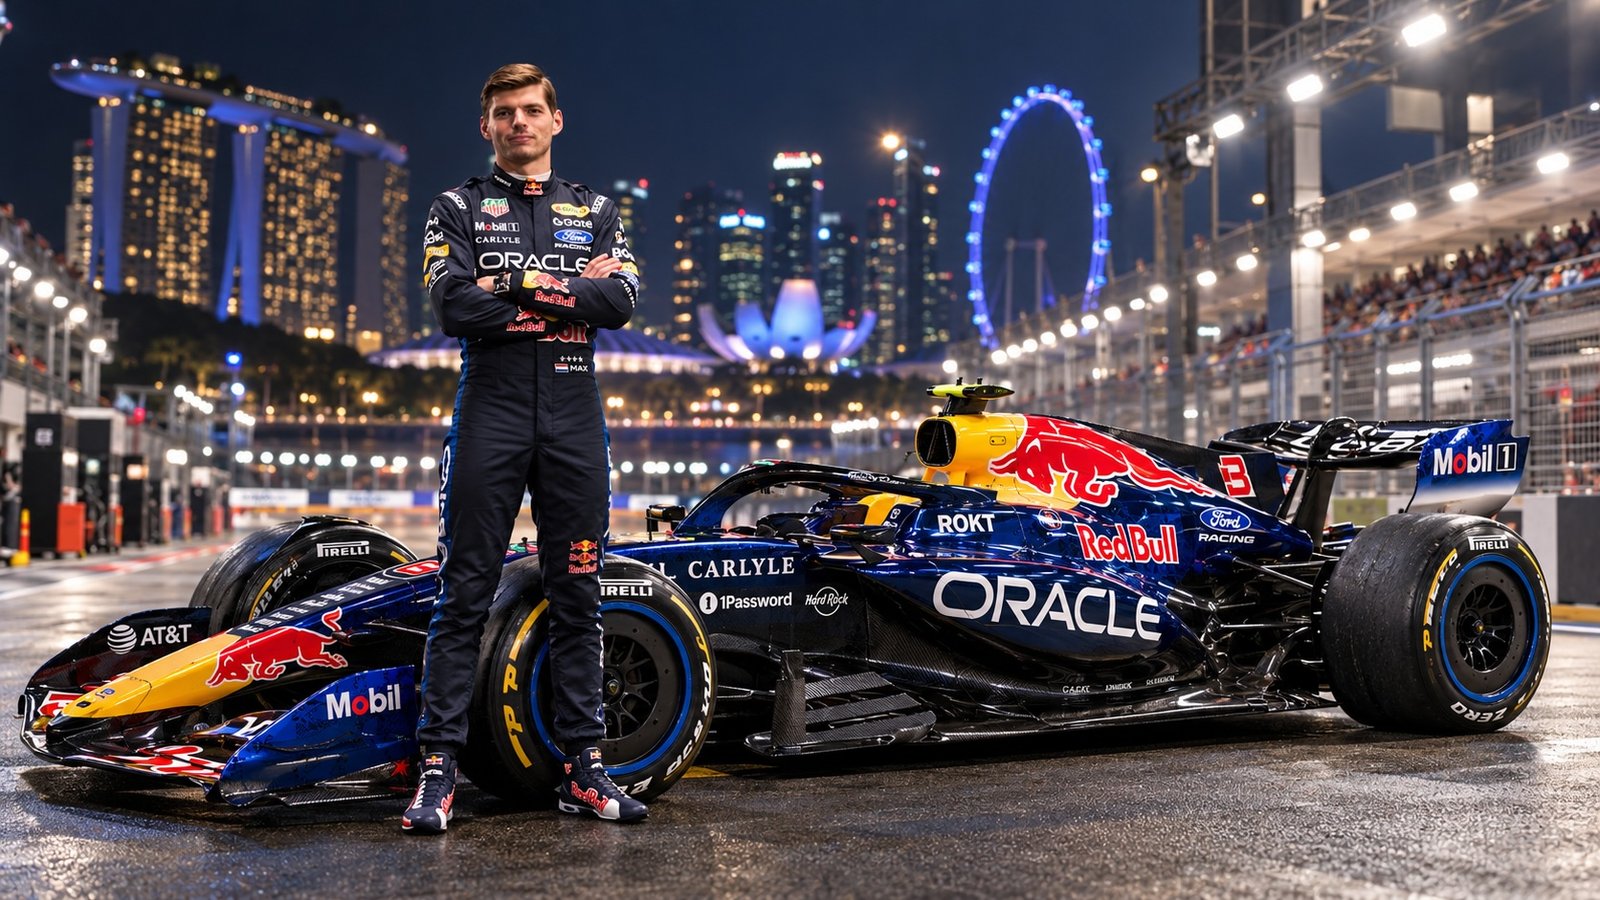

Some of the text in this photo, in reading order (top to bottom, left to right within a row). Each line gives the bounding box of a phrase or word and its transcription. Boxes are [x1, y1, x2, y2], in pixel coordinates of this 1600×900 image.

[475, 236, 520, 244] CARLYLE
[479, 252, 590, 272] ORACLE
[1433, 444, 1493, 475] Mobil
[1217, 455, 1256, 497] 3
[937, 513, 996, 533] ROKT
[1210, 511, 1241, 529] Ford
[1074, 522, 1179, 564] Red Bull
[1198, 533, 1255, 544] RACING
[1468, 534, 1509, 550] PIRELLI
[316, 540, 369, 558] PIRELLI
[688, 556, 795, 579] CARLYLE
[599, 578, 653, 597] IRELLI
[720, 591, 792, 610] 1Password
[805, 592, 849, 606] Hard Rock
[933, 571, 1162, 641] ORACLE
[140, 623, 192, 647] AT&T
[326, 683, 401, 720] Mobil
[1450, 701, 1508, 723] ZERO
